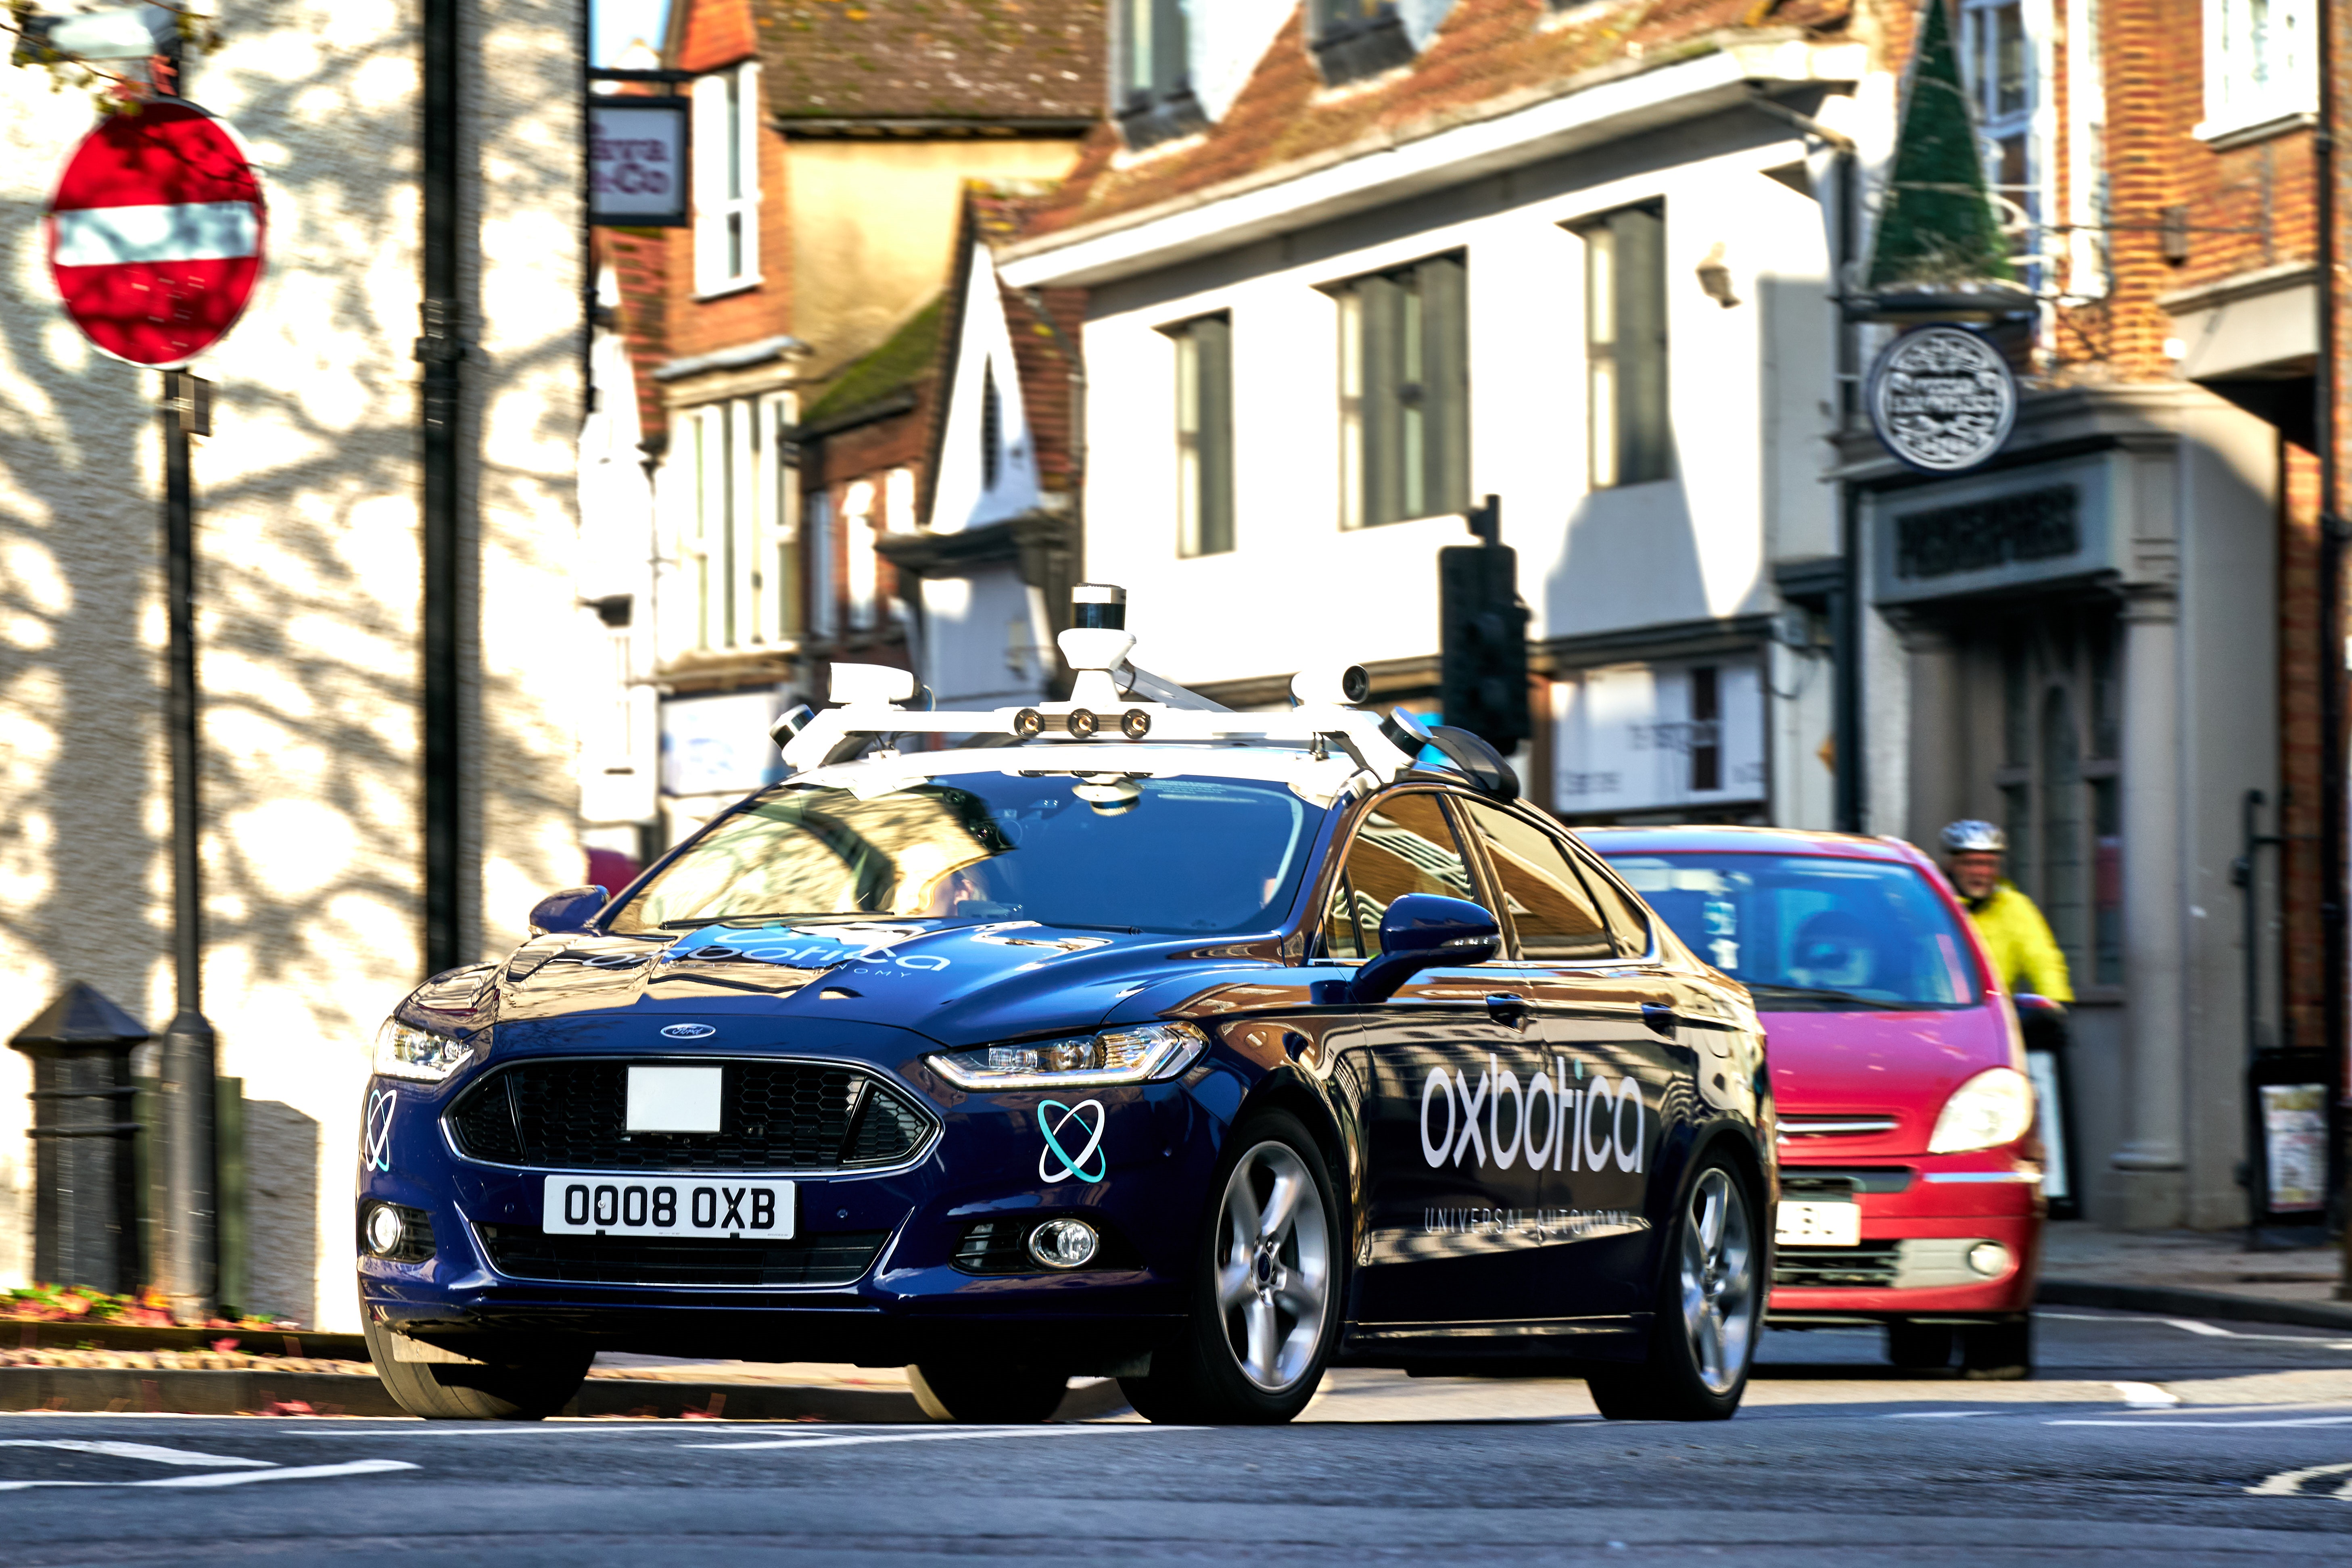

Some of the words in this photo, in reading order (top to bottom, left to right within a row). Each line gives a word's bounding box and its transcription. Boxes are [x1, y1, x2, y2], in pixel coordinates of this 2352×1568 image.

[672, 1025, 704, 1035] Ford
[1420, 1052, 1645, 1173] oxbotica
[691, 1187, 775, 1229] OXB
[1425, 1207, 1528, 1234] UNIVERSAL
[1536, 1209, 1630, 1235] AUTONOMY
